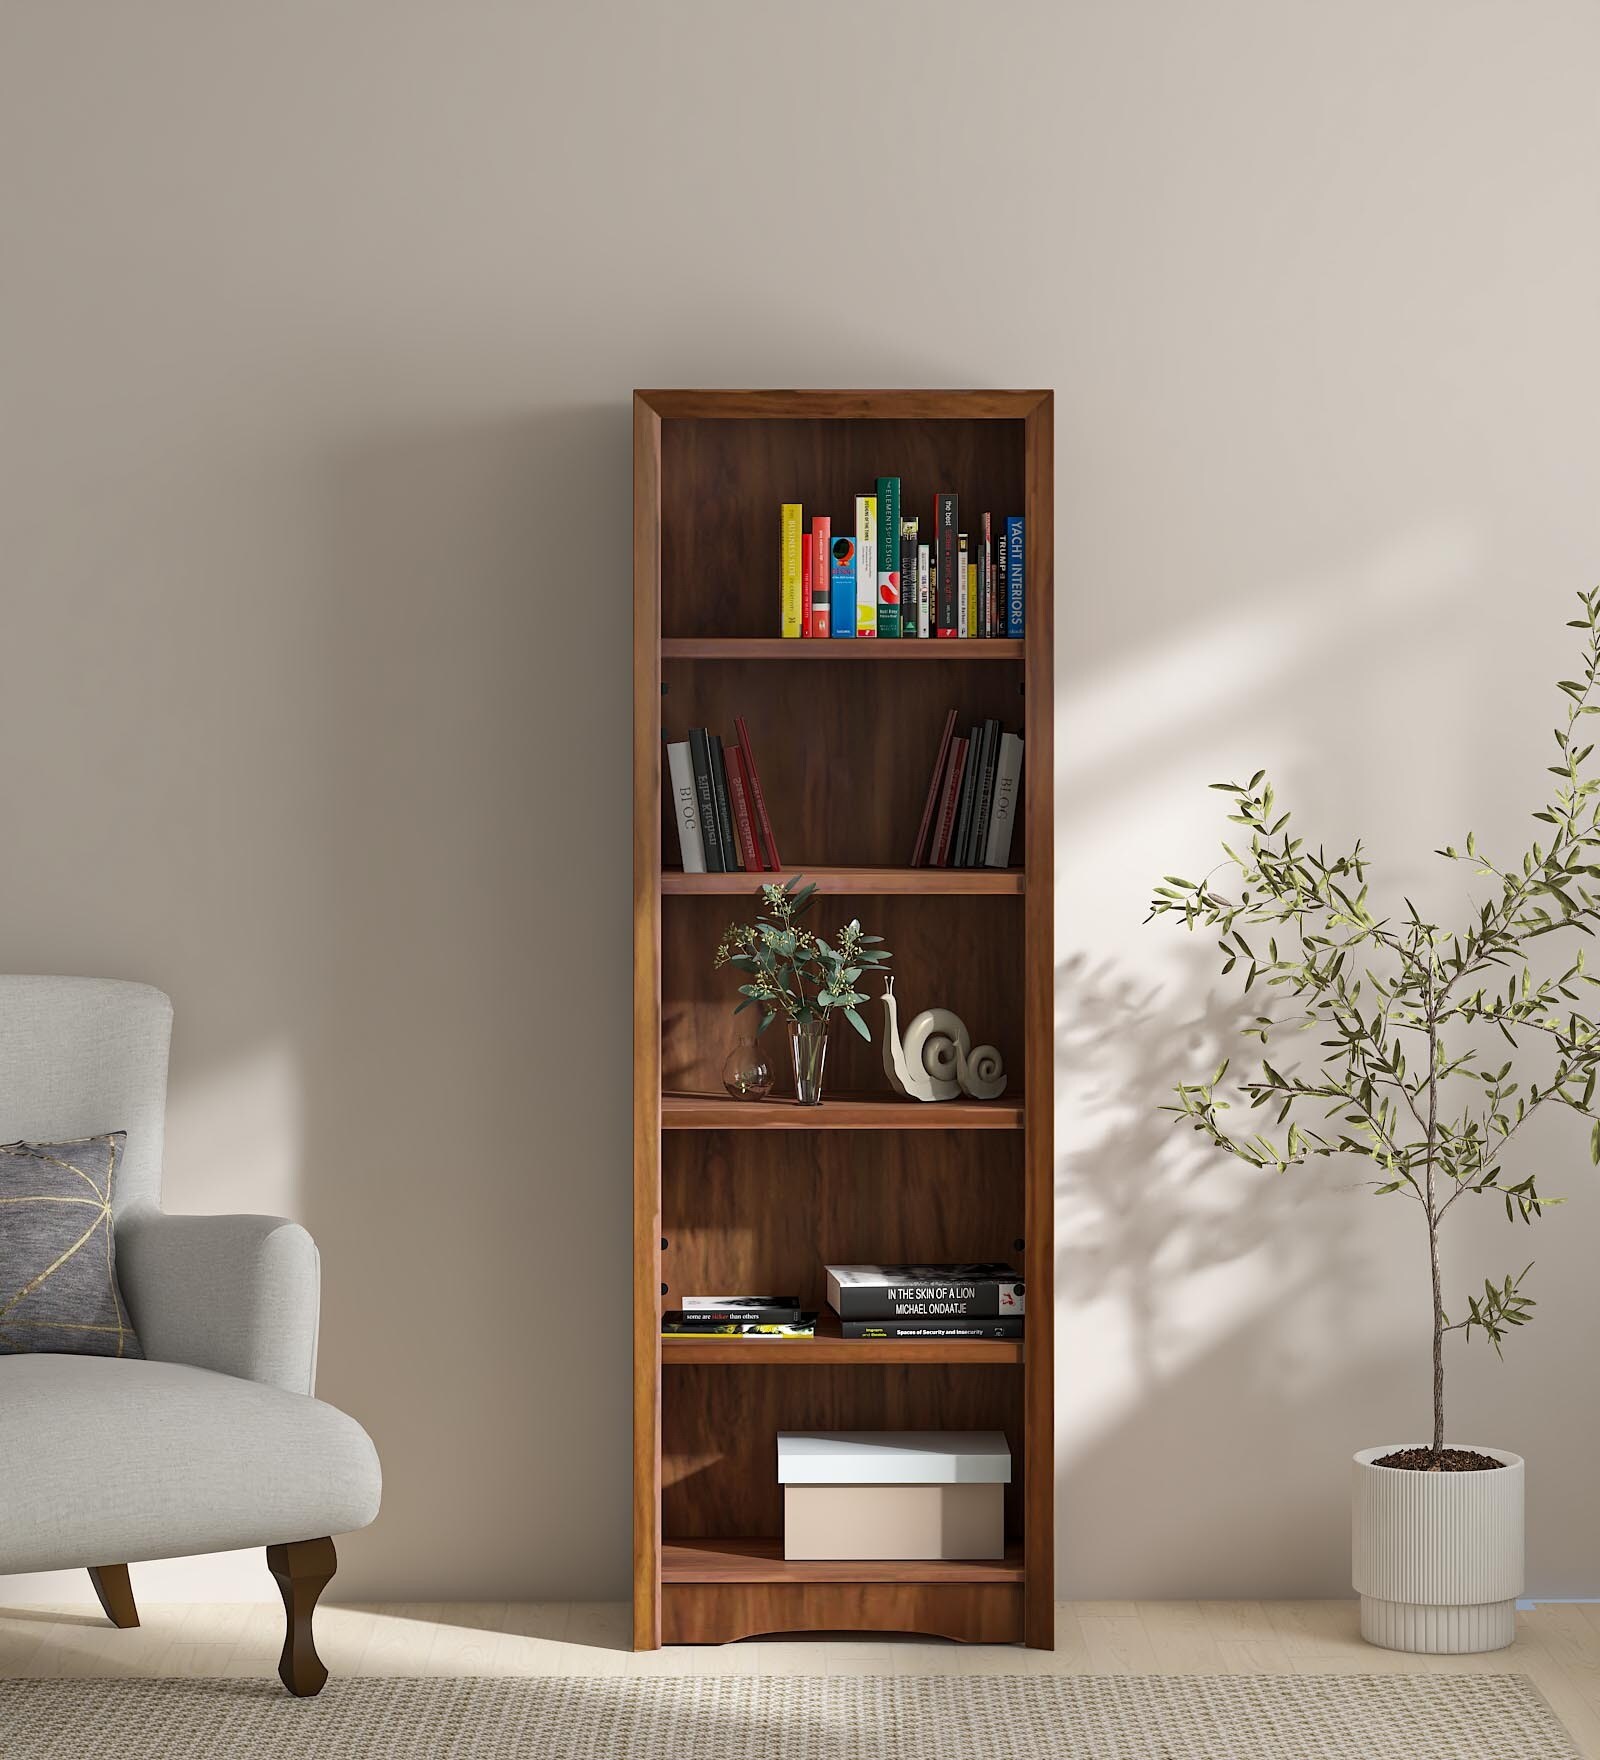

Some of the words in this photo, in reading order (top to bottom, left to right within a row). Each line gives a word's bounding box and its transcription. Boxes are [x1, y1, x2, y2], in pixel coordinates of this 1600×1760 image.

[788, 520, 797, 558] BUSINESS
[1012, 521, 1023, 559] YACHT
[788, 559, 797, 577] SIDE
[1012, 563, 1023, 625] INTERIORS
[995, 777, 1012, 821] BLOG
[888, 1288, 897, 1300] IN
[898, 1288, 914, 1300] THE
[915, 1288, 935, 1299] SKIN
[936, 1288, 948, 1299] OF
[949, 1288, 955, 1299] A
[956, 1287, 975, 1298] LION
[895, 1304, 928, 1315] MICHAEL
[929, 1303, 967, 1314] ONDAATJE
